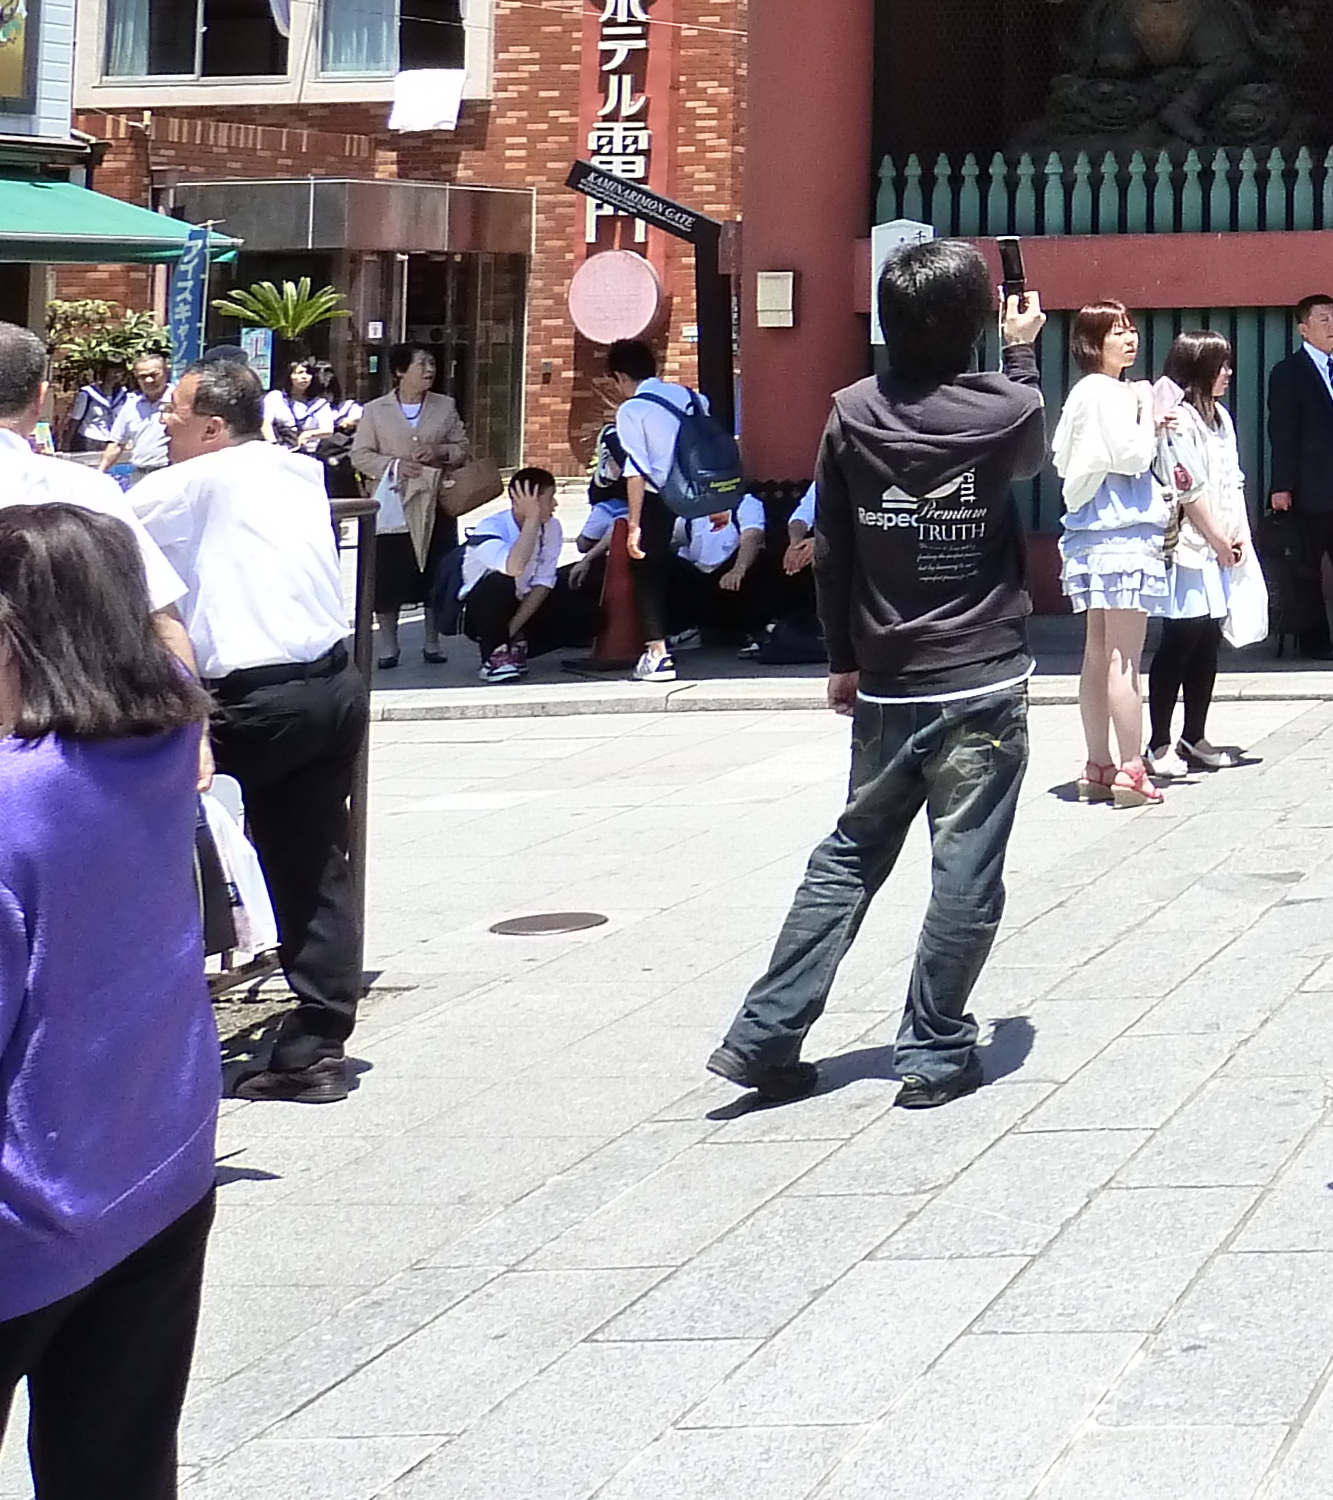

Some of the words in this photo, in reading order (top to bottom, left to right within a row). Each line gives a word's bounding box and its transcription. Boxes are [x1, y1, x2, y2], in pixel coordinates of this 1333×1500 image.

[586, 172, 666, 214] KAMINARIMON
[665, 207, 696, 228] GATE
[959, 467, 978, 504] ent
[917, 500, 988, 521] Premium
[917, 522, 986, 541] TRUTH
